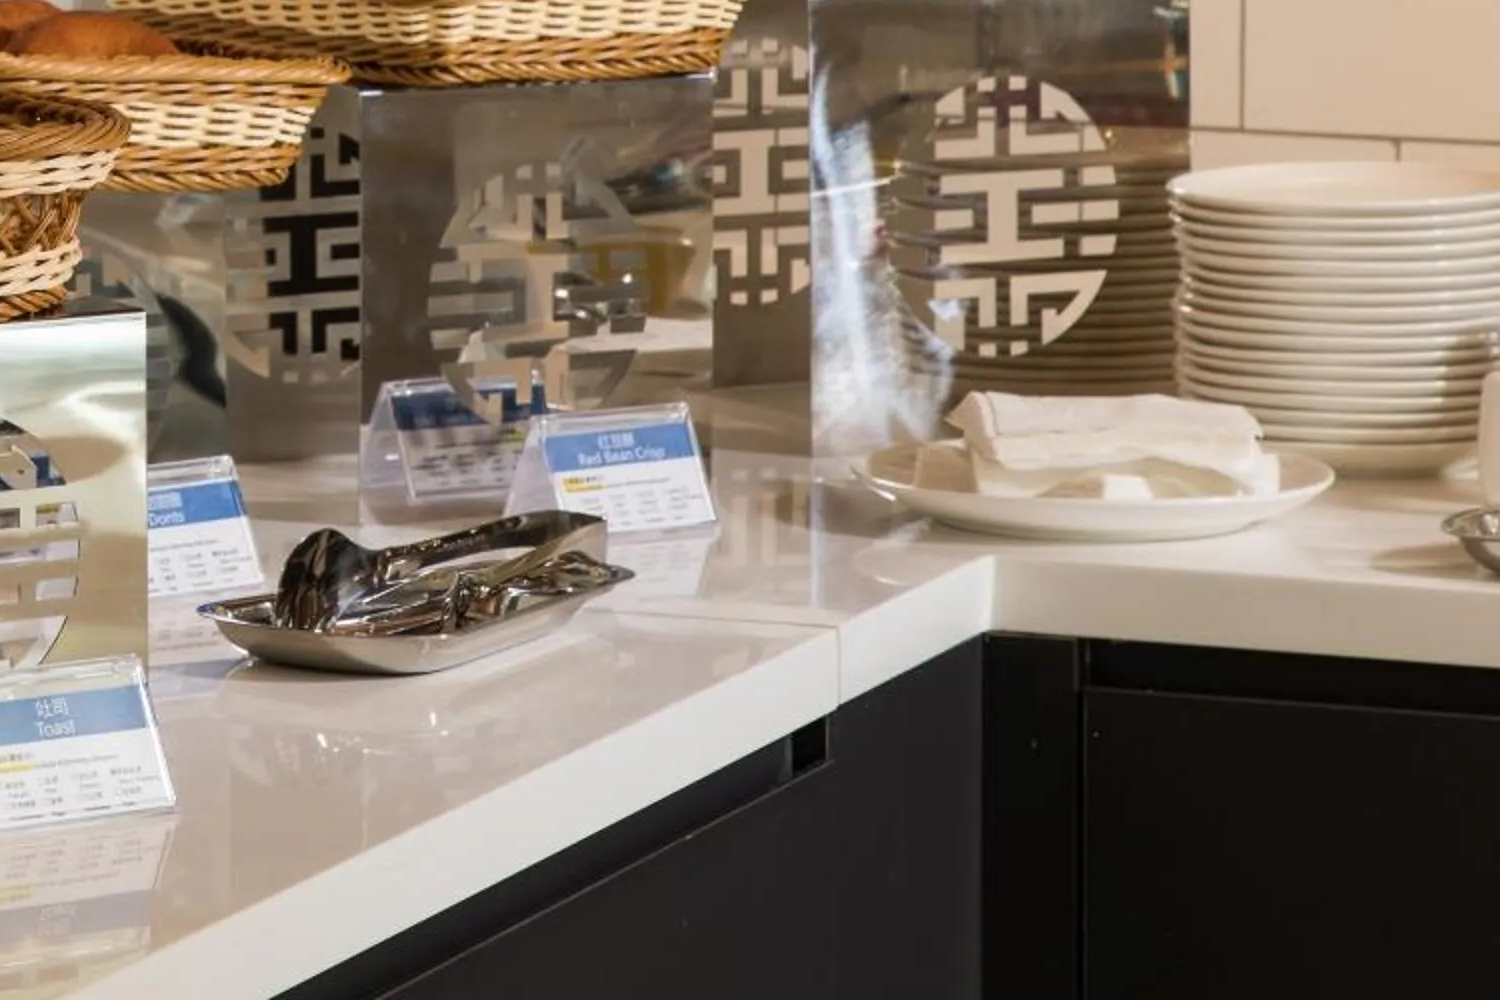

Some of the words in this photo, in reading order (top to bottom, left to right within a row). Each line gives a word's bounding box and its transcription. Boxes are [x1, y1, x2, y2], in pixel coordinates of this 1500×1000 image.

[577, 450, 602, 465] Red
[603, 447, 634, 463] Bean
[35, 695, 69, 719] 吐司
[33, 719, 77, 738] Toast
